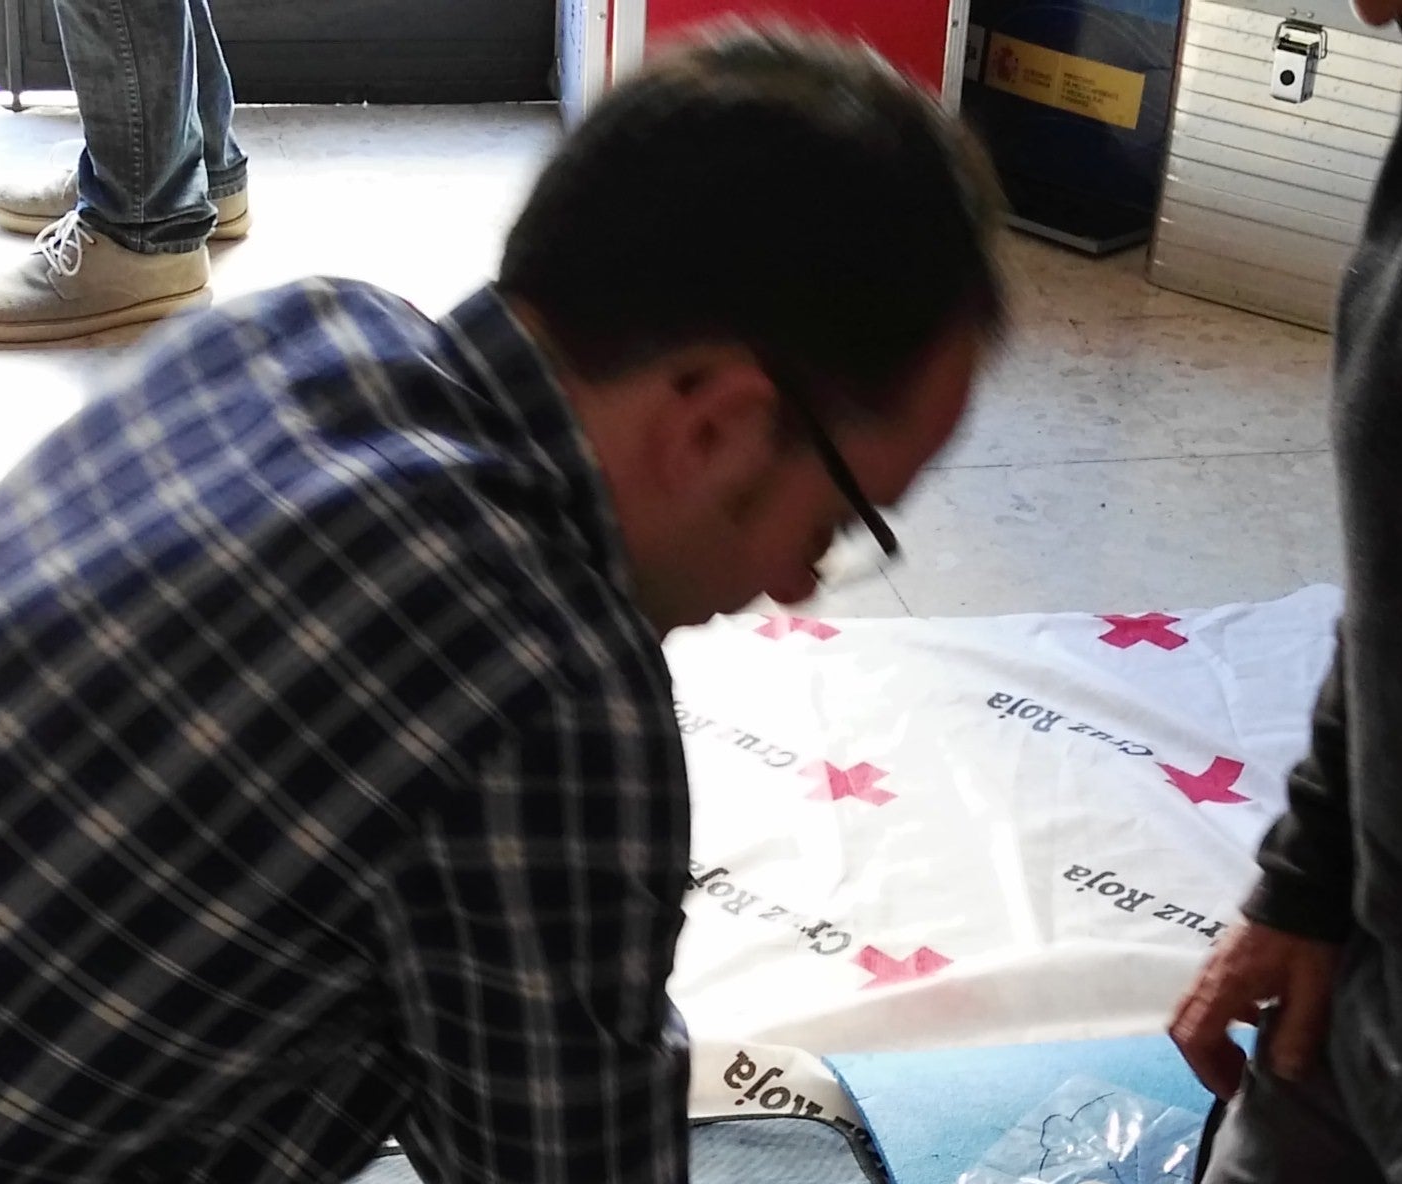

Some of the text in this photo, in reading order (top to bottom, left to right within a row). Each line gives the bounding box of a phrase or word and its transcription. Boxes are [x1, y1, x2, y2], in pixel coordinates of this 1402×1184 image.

[987, 692, 1154, 756] Cruz Roja
[758, 904, 852, 956] Crz
[1063, 865, 1229, 946] ruz Roja
